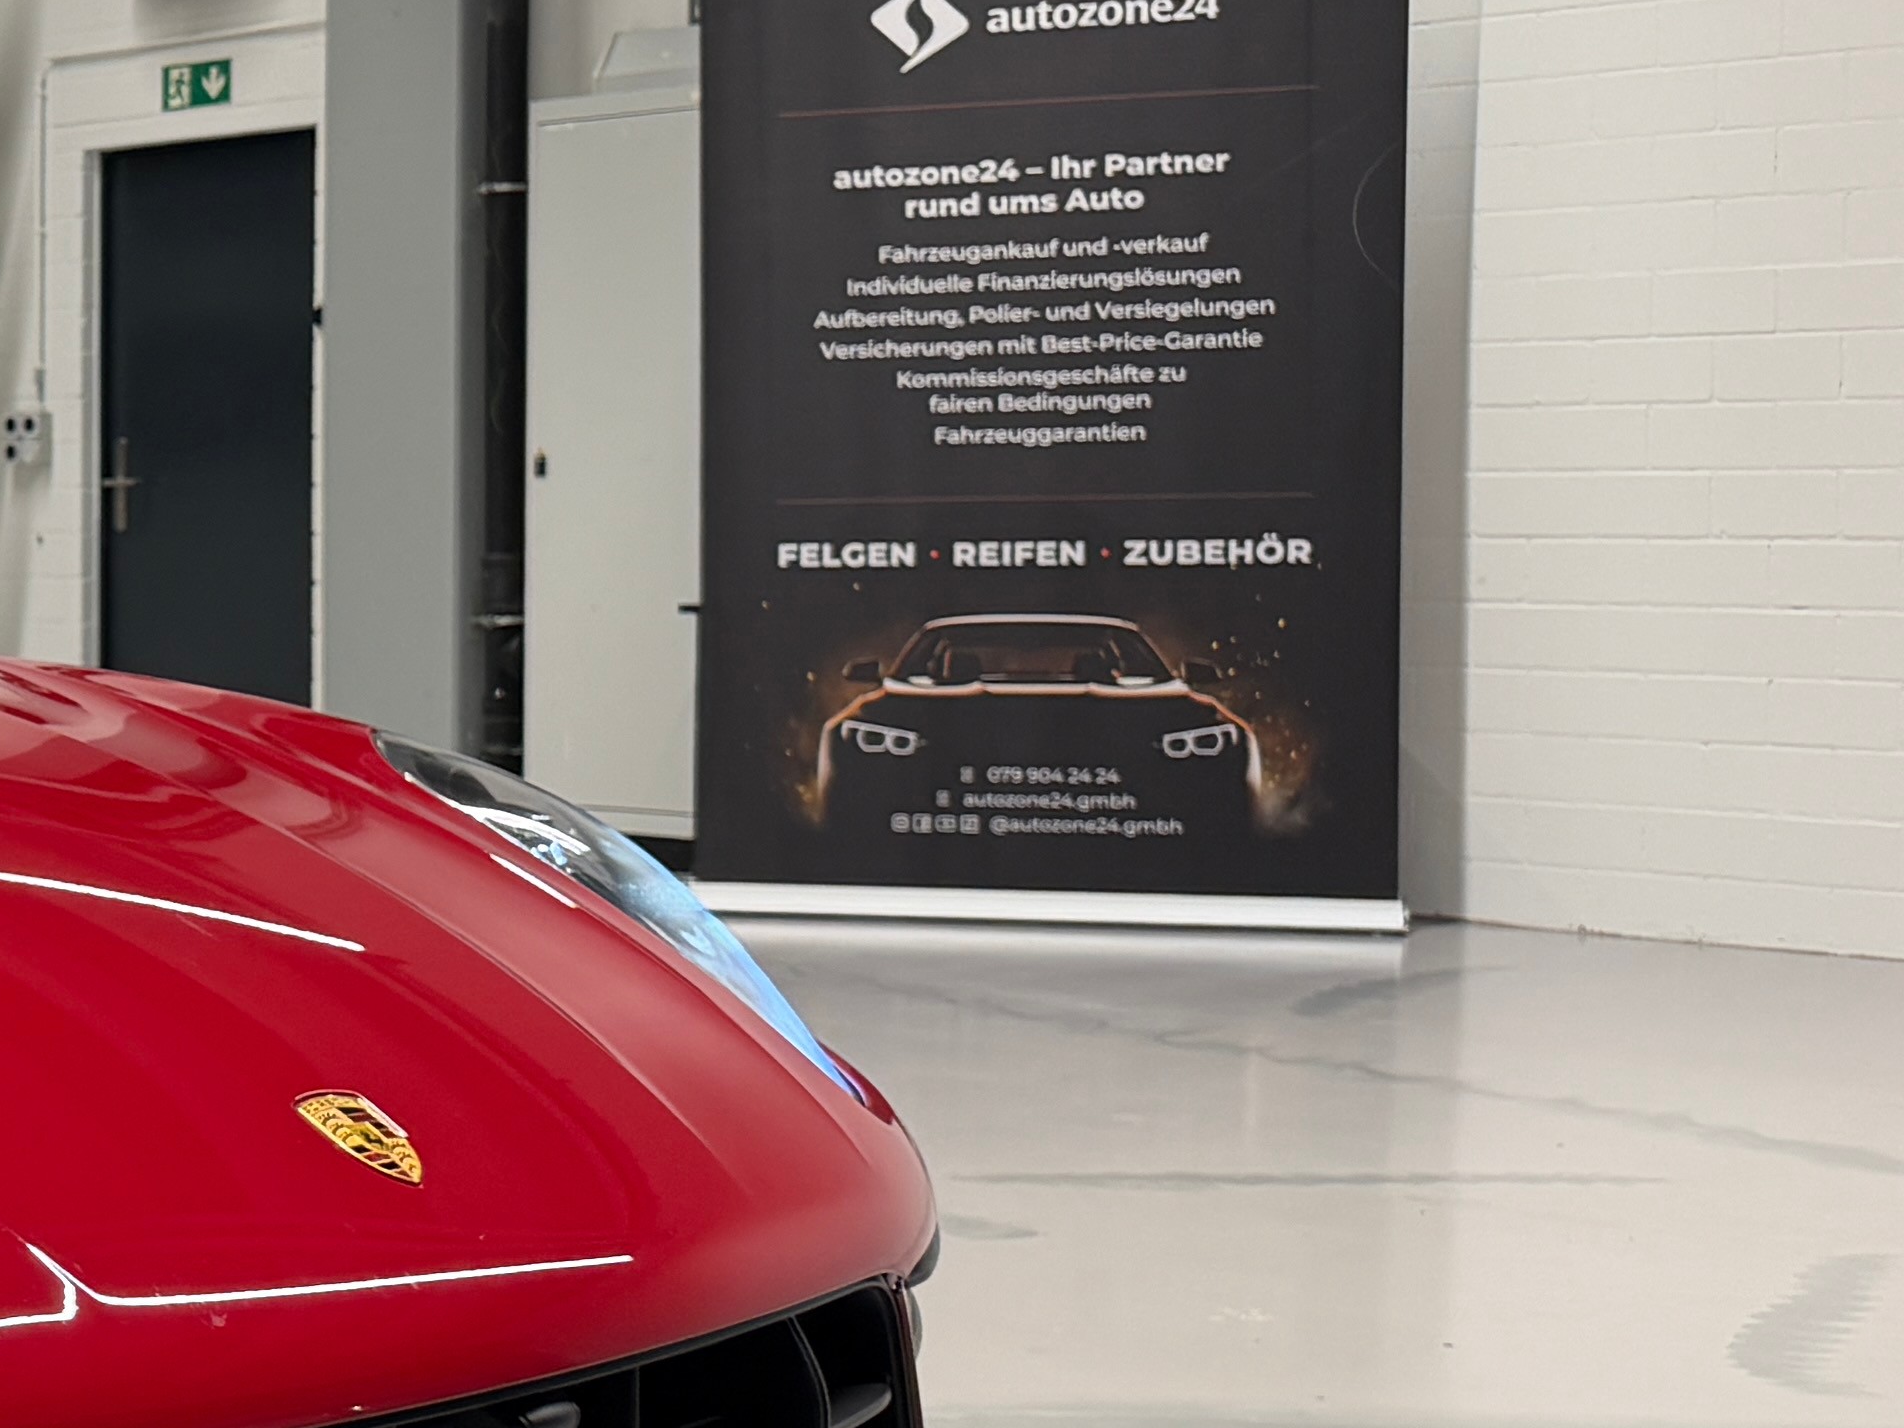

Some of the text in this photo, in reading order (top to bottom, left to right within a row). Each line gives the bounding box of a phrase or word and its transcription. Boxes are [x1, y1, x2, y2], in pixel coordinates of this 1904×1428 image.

[833, 159, 1019, 190] autozone24
[1050, 154, 1097, 180] Ihr
[1104, 150, 1231, 178] Partner
[904, 186, 1145, 219] rund ums Auto
[878, 232, 1210, 265] Fahrzeugankauf und -verkauf
[847, 265, 1242, 298] Individuelle Finanzierungslösungen
[970, 302, 1040, 325] Polier-
[1045, 301, 1091, 322] und
[1095, 295, 1276, 322] Versiegelungen
[819, 328, 1264, 361] Versicherungen mit Best-Price-Garantie
[896, 363, 1188, 390] Kommissionsgeschäfte zu
[929, 390, 1152, 415] fairen Bedingungen
[934, 422, 1148, 447] Fahrzeuggarantien
[777, 532, 1312, 570] FELGEN REIFEN ZUBEHÖR
[1067, 767, 1093, 785] 24
[1095, 767, 1122, 785] 24
[962, 789, 1137, 813] autozone24.gmbh
